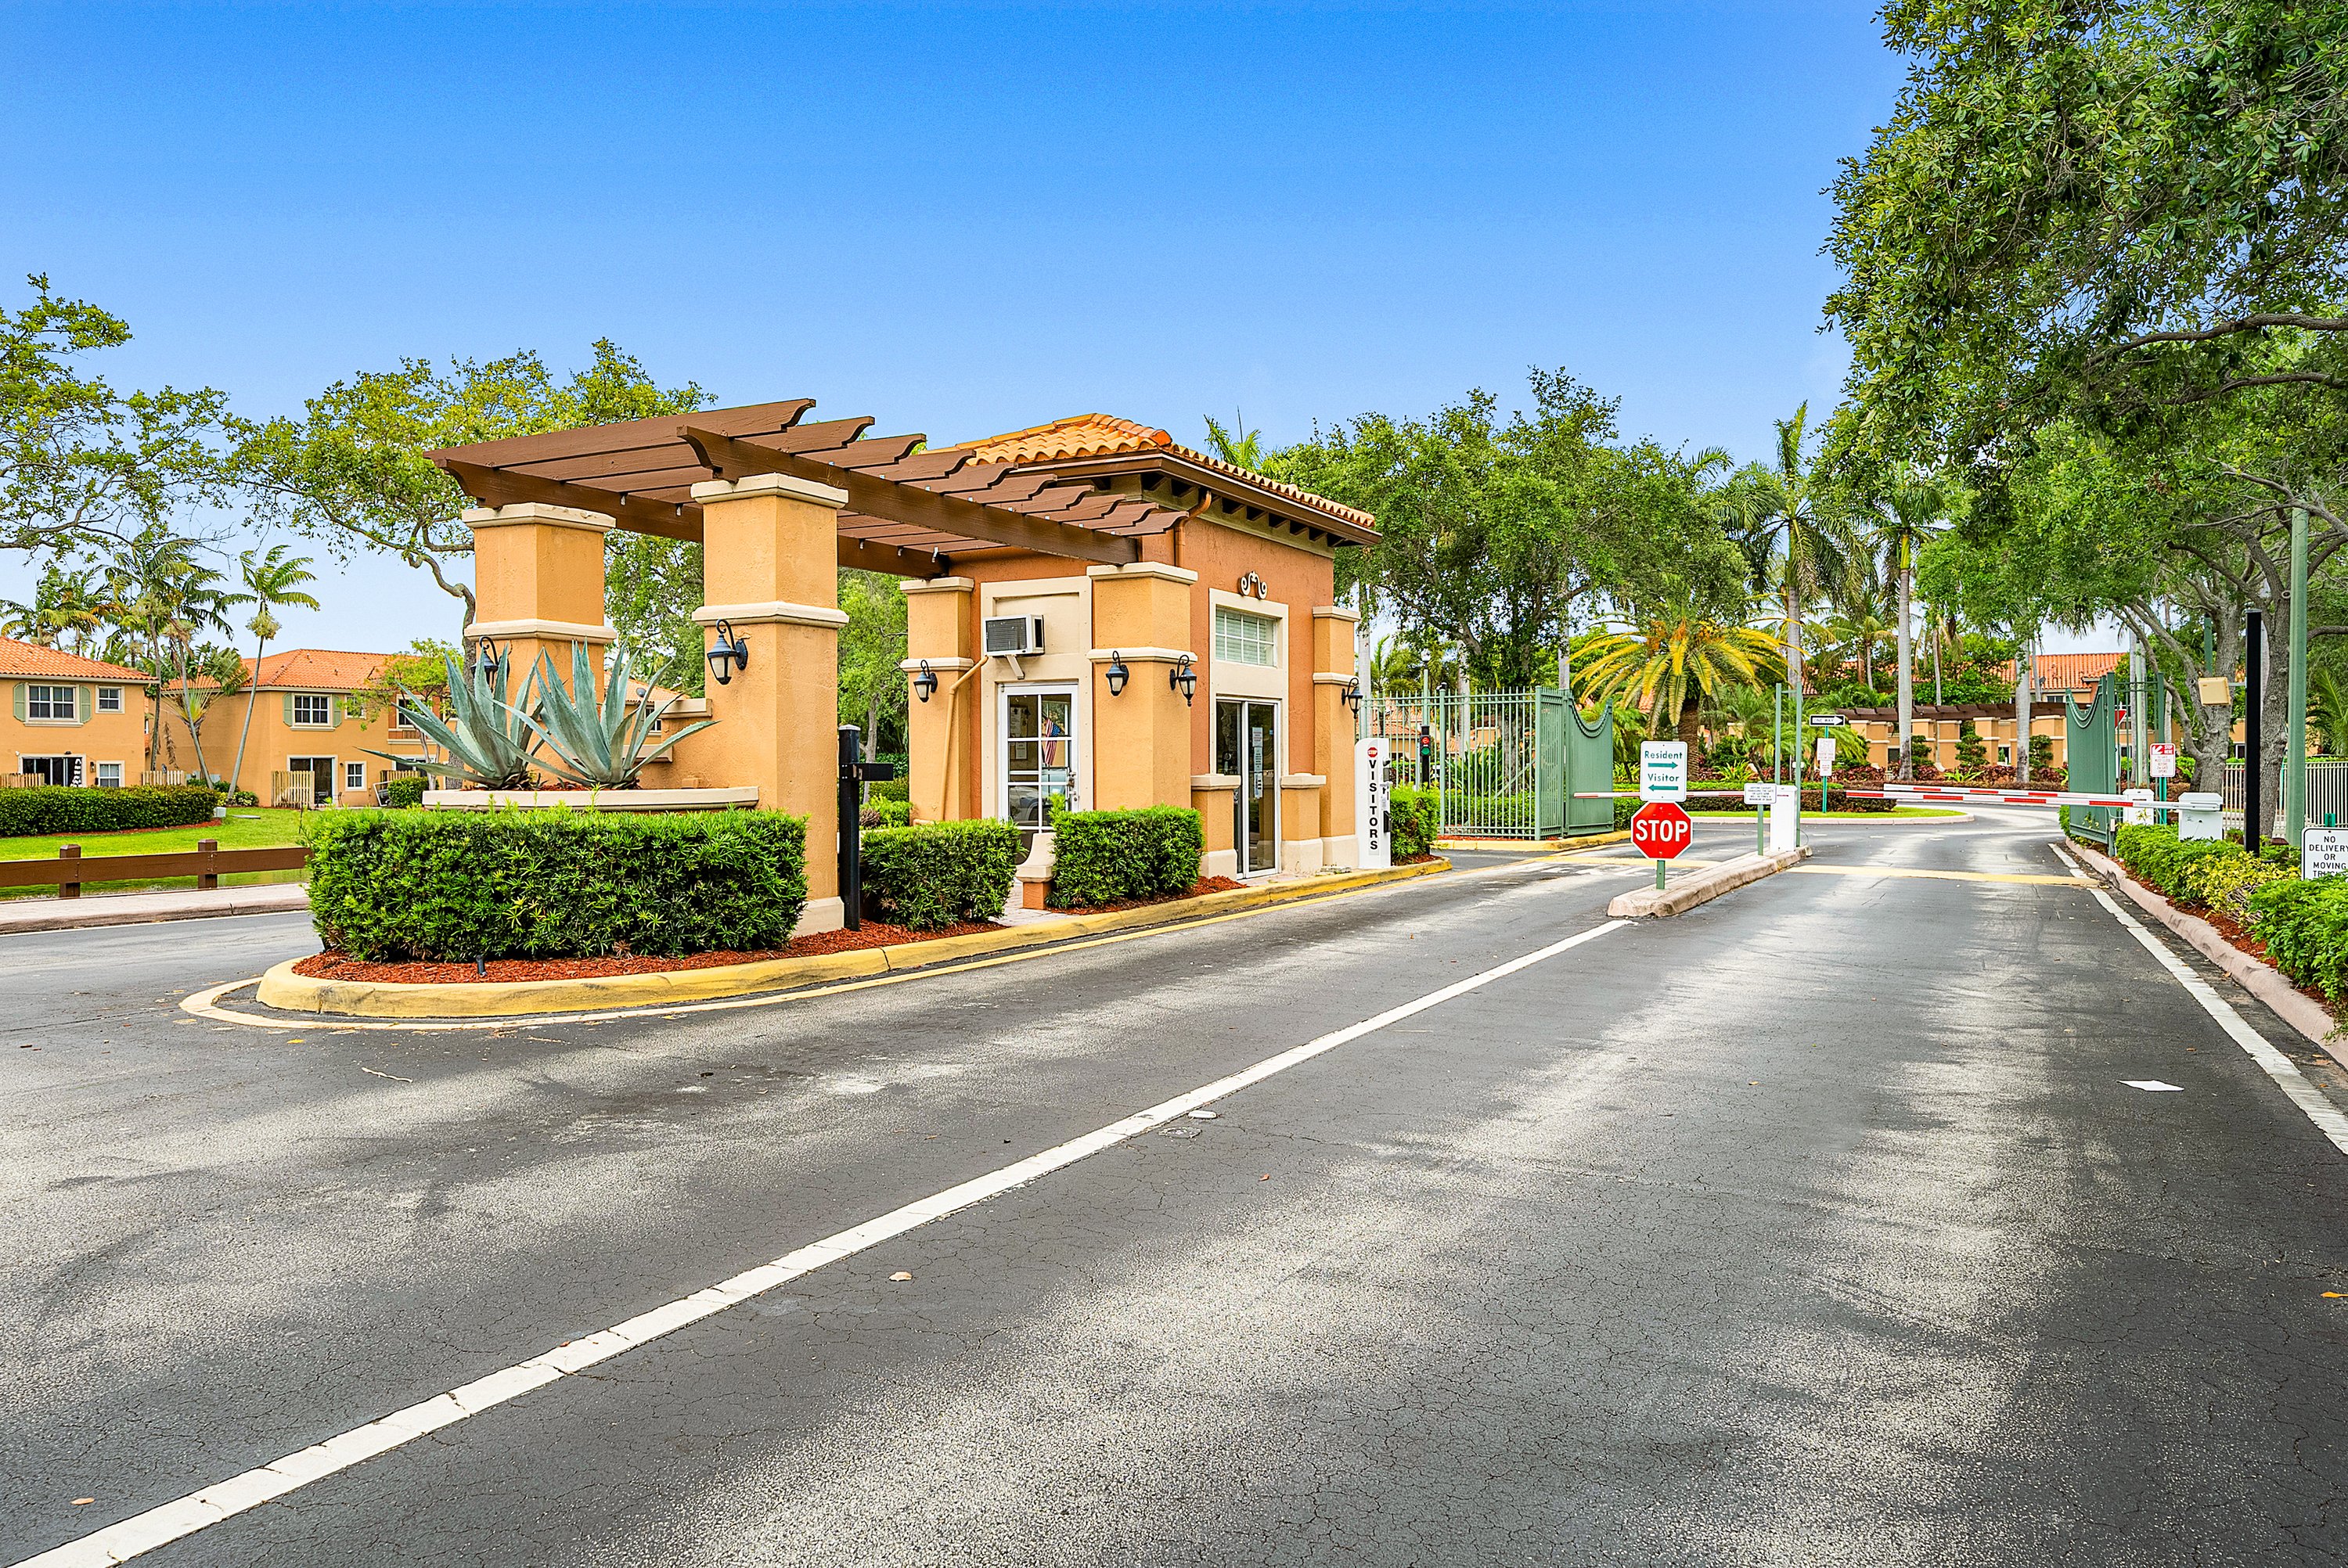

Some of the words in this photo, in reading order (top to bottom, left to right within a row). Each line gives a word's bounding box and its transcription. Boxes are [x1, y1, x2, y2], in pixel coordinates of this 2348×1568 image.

[1644, 750, 1683, 759] Resident
[1648, 773, 1680, 782] Visitor
[1369, 760, 1378, 850] VISITORS
[1635, 819, 1688, 842] STOP
